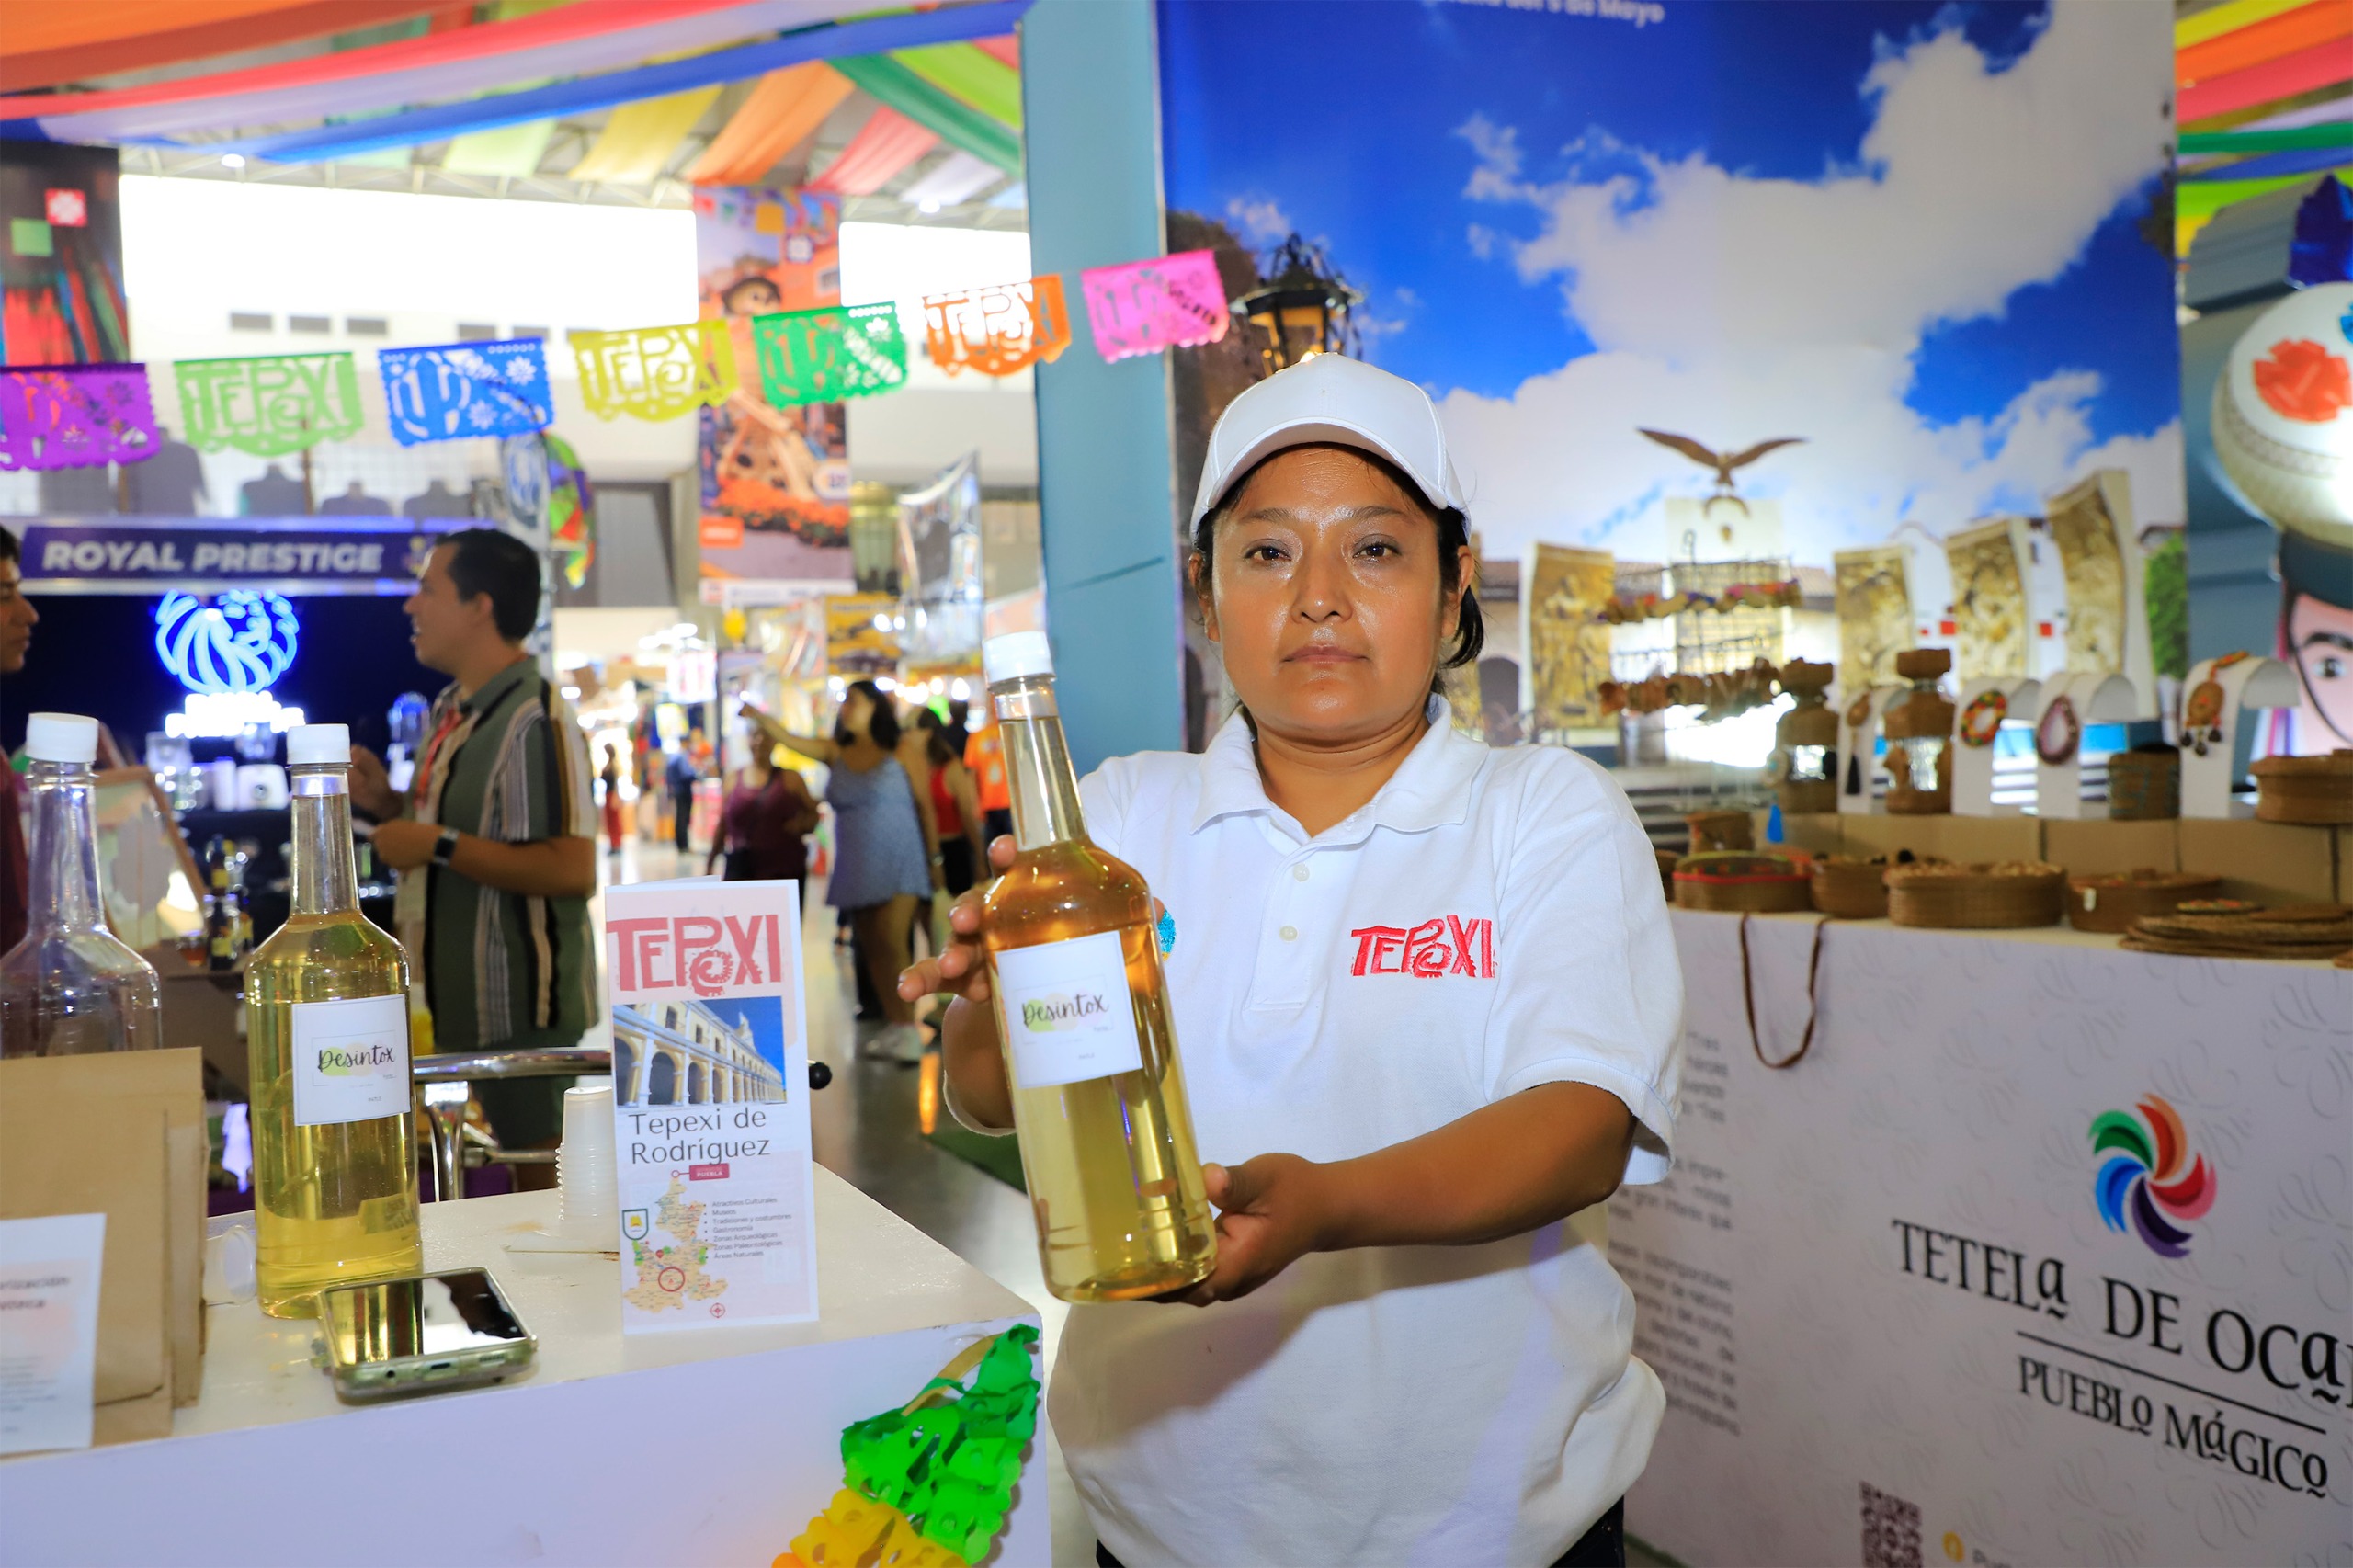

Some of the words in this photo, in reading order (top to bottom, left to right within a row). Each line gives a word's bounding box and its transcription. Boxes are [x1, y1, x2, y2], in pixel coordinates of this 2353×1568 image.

[1598, 0, 1665, 28] Mayo
[42, 540, 182, 571] ROYAL
[192, 541, 383, 574] PRESTIGE
[607, 914, 782, 997] TEPEXI
[1351, 915, 1495, 978] TEPEXI
[629, 1108, 722, 1140] Tepexi
[734, 1107, 767, 1129] de
[631, 1138, 770, 1166] Rodríguez
[713, 1225, 753, 1233] Gastronomía
[755, 1214, 792, 1222] costumbres
[733, 1233, 778, 1242] Arqueológicas
[733, 1250, 764, 1258] Naturales
[2102, 1275, 2183, 1356] DE
